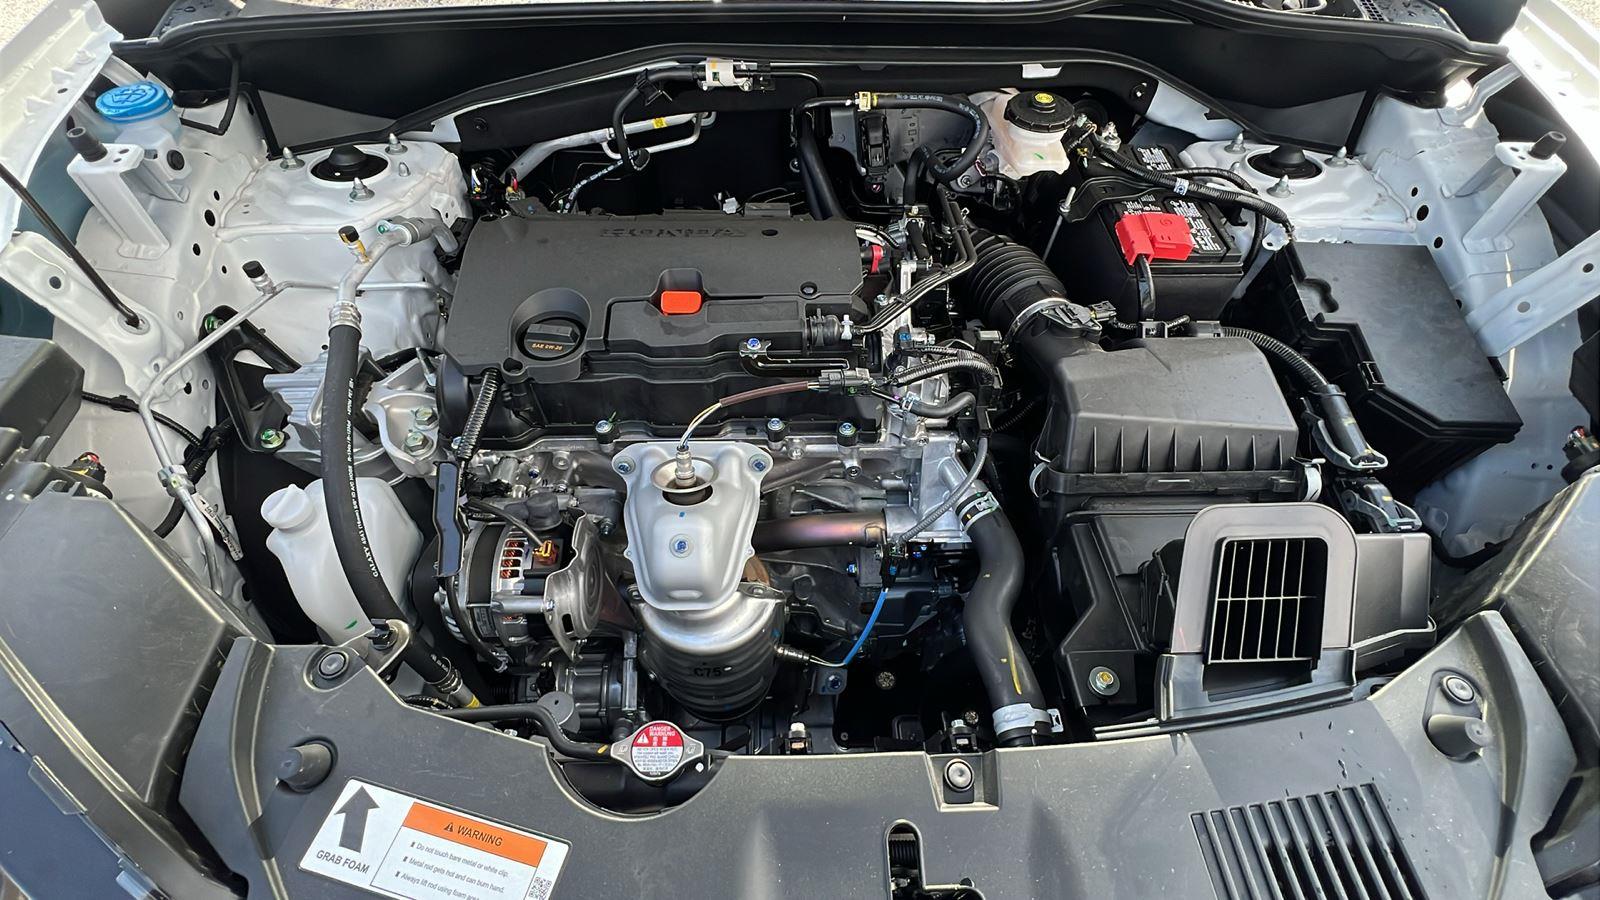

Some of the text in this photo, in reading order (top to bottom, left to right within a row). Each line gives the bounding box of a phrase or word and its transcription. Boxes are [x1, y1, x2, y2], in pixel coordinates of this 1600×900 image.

[363, 546, 379, 578] GALAXY
[693, 666, 722, 678] C75
[457, 824, 504, 847] WARNING
[316, 849, 370, 874] GRAB FOAM
[416, 842, 425, 851] Do
[425, 846, 434, 854] not
[434, 849, 449, 858] touch
[449, 853, 461, 862] bare
[461, 858, 477, 868] metal
[484, 865, 498, 874] white
[400, 872, 420, 885] Always
[420, 878, 428, 887] lift
[427, 882, 438, 890] rod
[437, 886, 452, 896] using
[452, 888, 467, 899] foam
[408, 857, 424, 868] Metal
[424, 863, 434, 871] rod
[432, 866, 445, 875] gets
[445, 870, 455, 878] hot
[455, 873, 466, 881] and
[466, 876, 476, 885] can
[476, 880, 489, 889] burn
